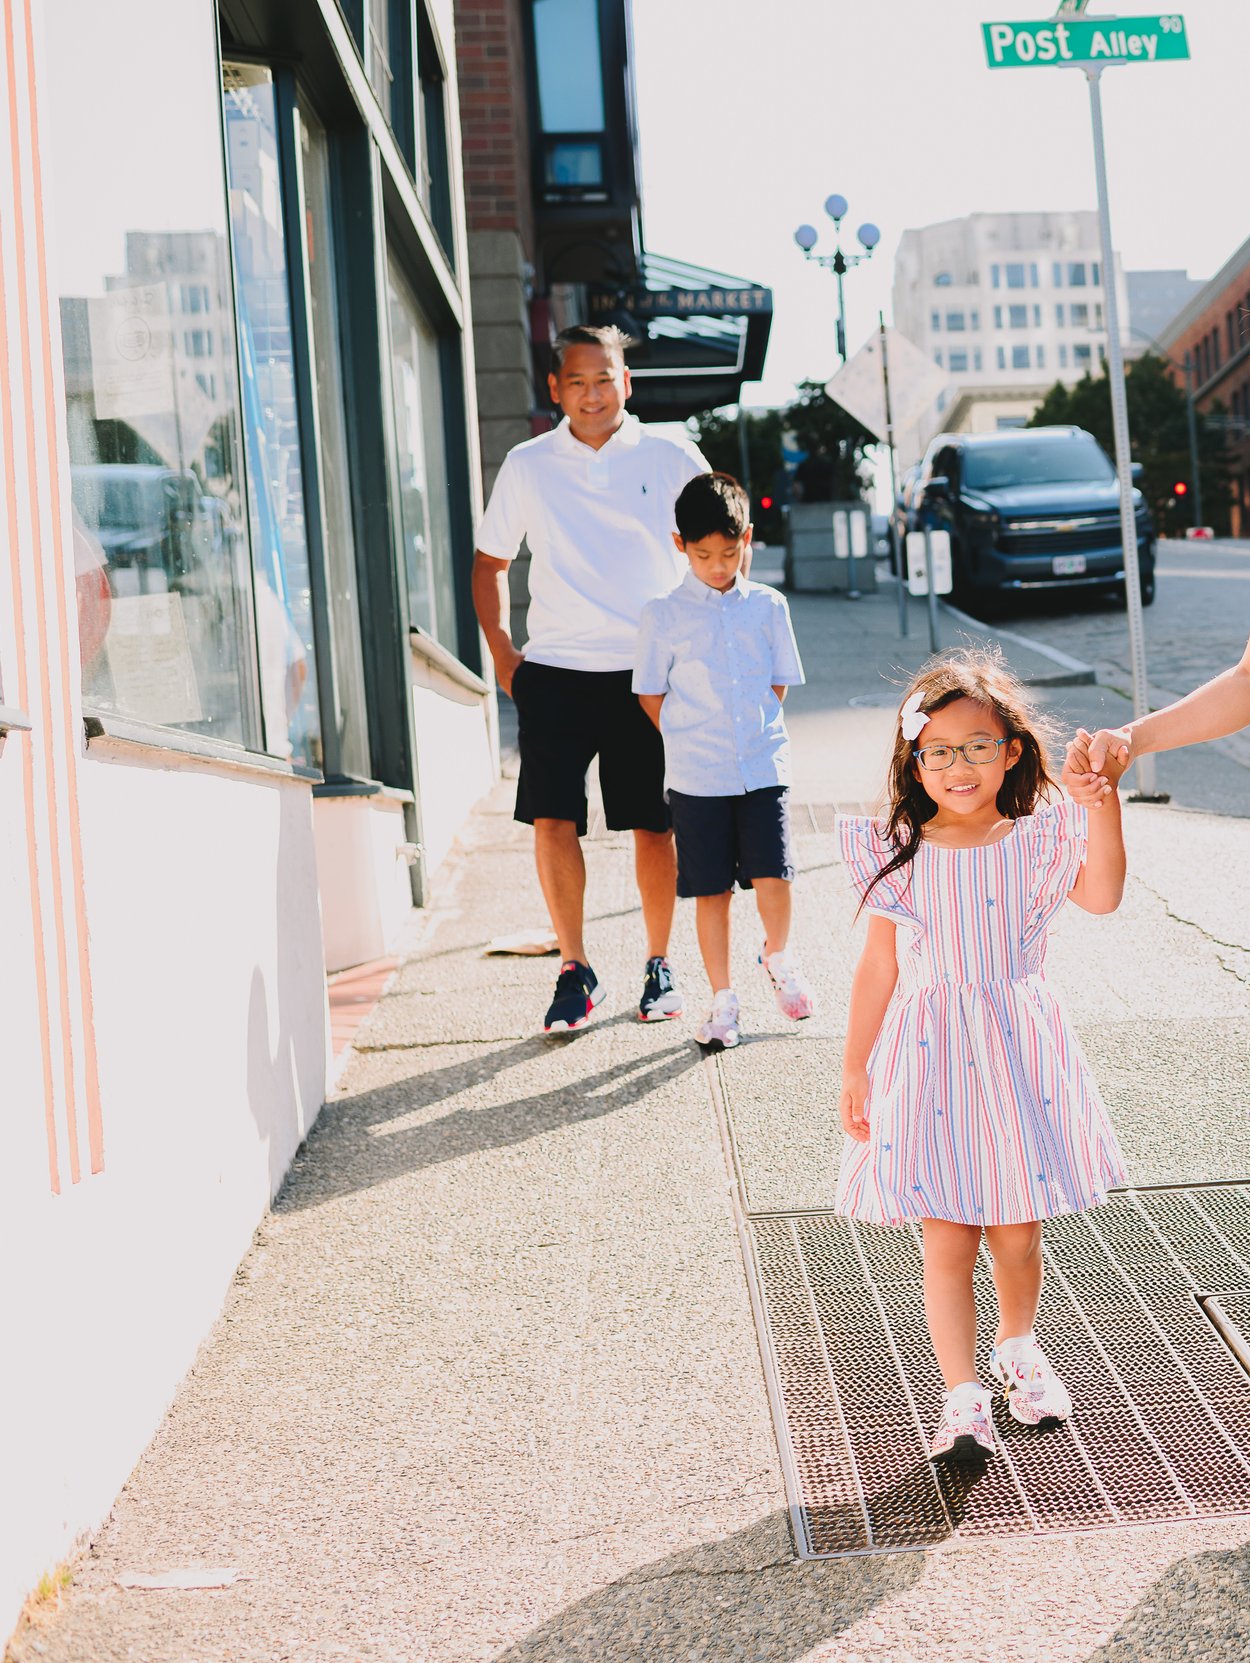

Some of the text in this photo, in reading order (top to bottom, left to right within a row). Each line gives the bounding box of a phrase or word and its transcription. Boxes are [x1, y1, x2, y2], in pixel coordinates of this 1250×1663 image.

[990, 16, 1183, 62] Post Alley 90
[676, 290, 766, 310] MARKET
